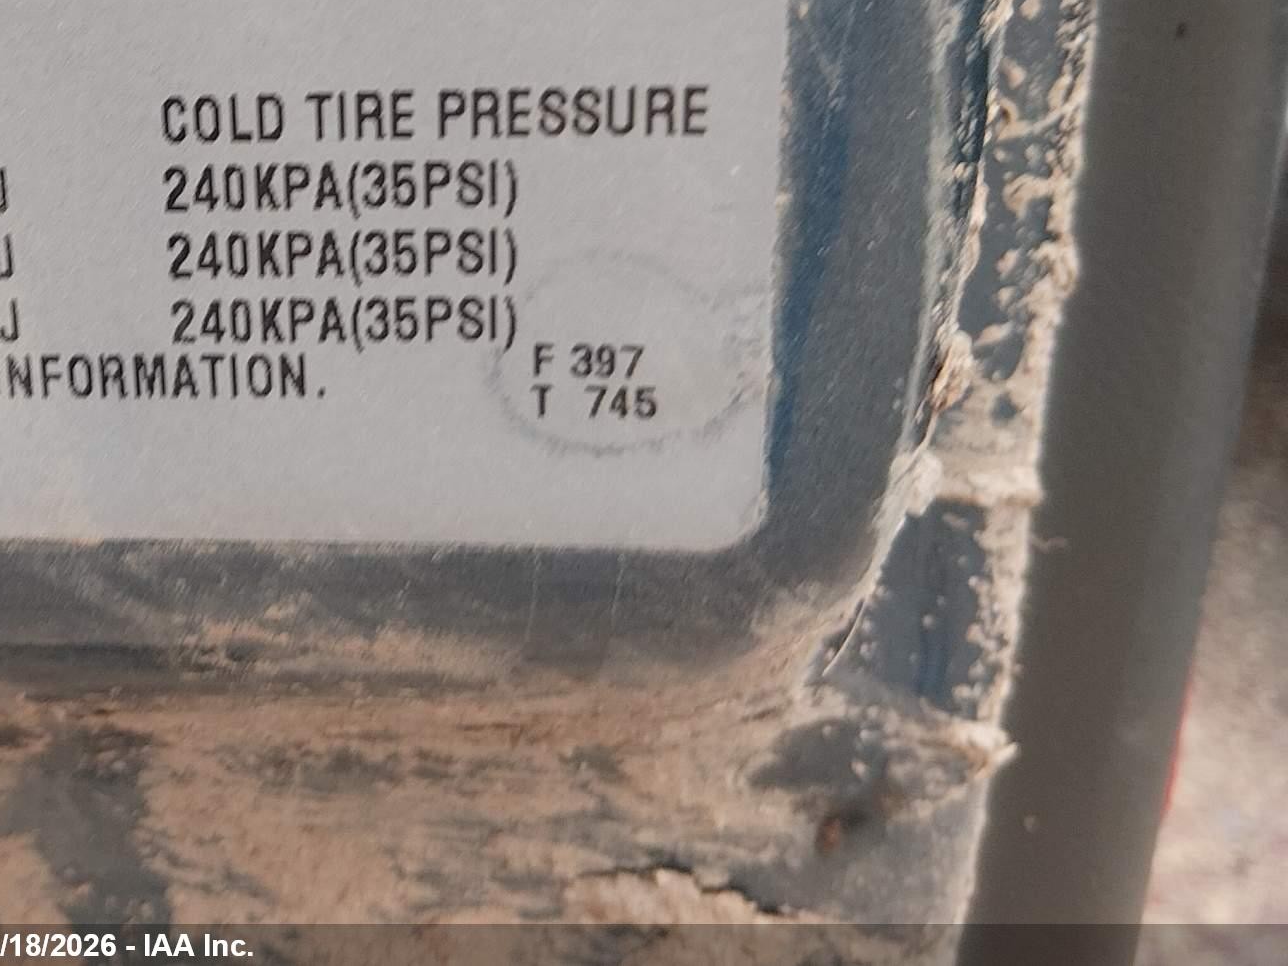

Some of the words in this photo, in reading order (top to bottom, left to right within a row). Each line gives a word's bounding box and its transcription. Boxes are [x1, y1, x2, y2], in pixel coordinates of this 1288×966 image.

[163, 93, 285, 144] COLD
[306, 89, 416, 141] TIRE
[437, 85, 709, 141] PRESSURE
[163, 158, 518, 219] 240KPA(35PSI)
[166, 228, 518, 288] 240KPA(35PSI)
[172, 294, 518, 352] 240KPA(35PSI)
[533, 343, 554, 377] F
[570, 343, 645, 379] 397
[531, 384, 554, 418] T
[584, 385, 657, 421] 745
